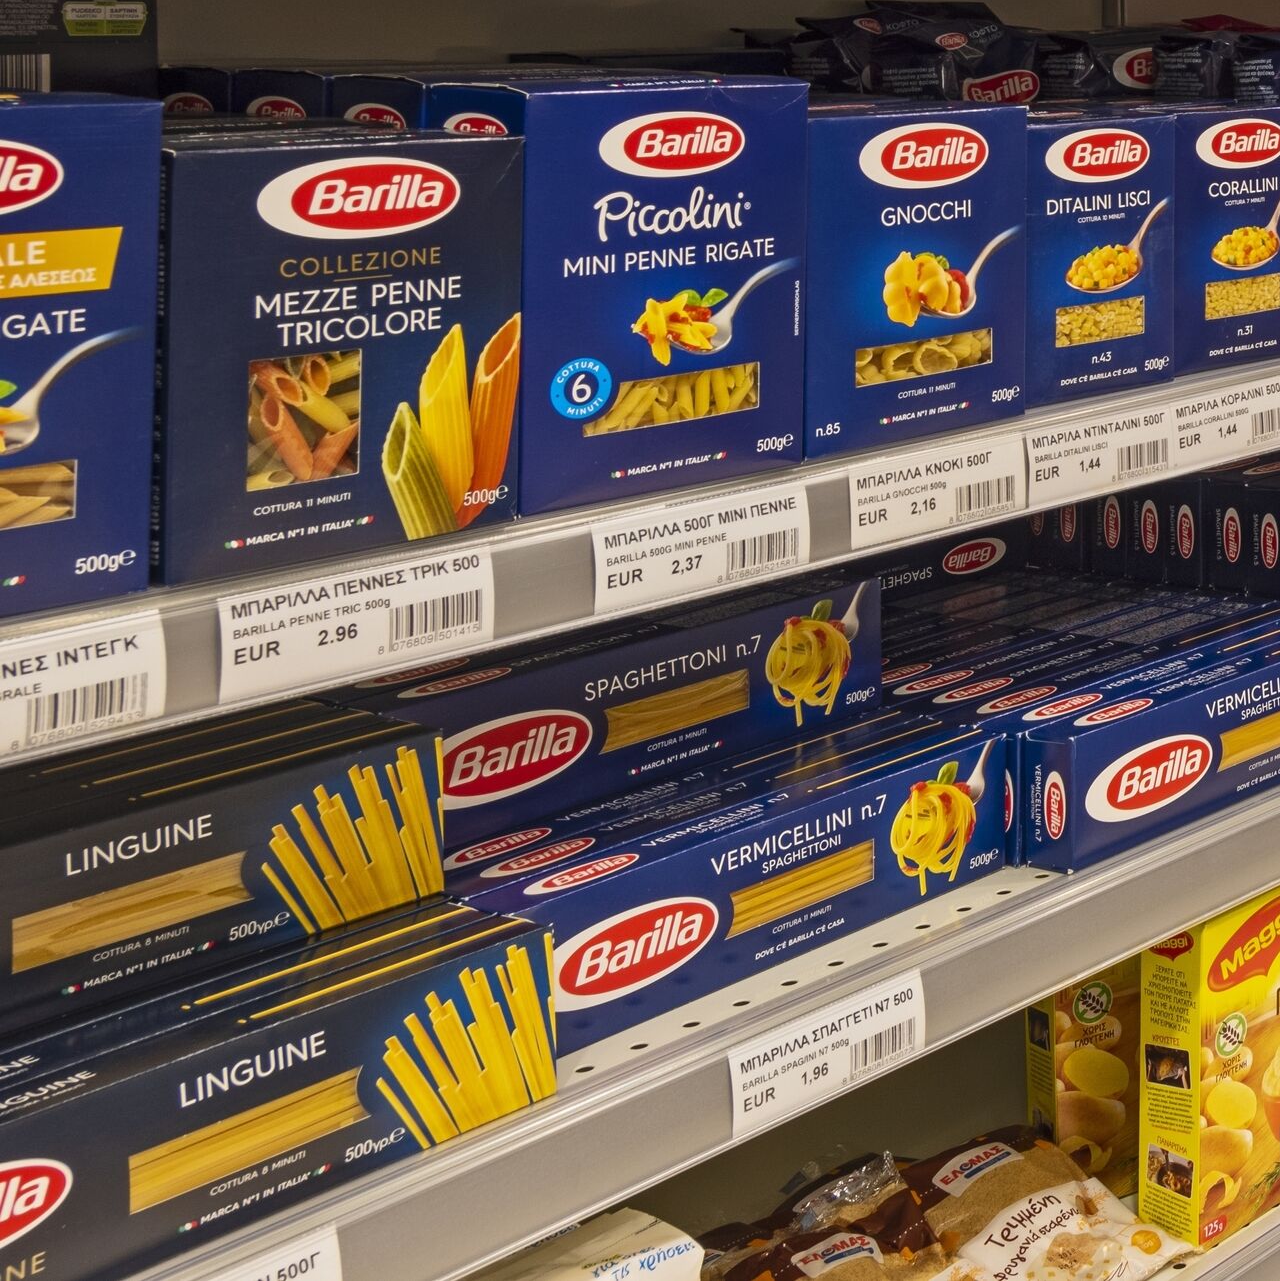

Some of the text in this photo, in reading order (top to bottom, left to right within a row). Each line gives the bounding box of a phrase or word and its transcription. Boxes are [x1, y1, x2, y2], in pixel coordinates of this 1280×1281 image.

[636, 125, 733, 158] Barilla
[892, 137, 978, 170] Barilla
[1072, 139, 1142, 168] Barilla
[1218, 128, 1280, 154] Barilla
[308, 176, 445, 216] Barilla
[1045, 189, 1151, 216] DITALINI LISCI
[1208, 176, 1279, 199] CORALLINI
[594, 186, 743, 241] Piccolini
[881, 200, 972, 227] GNOCCHI
[280, 247, 442, 279] COLLEZIONE
[563, 239, 775, 277] MINI PENNE RIGATE
[255, 276, 462, 319] MEZZE PENNE
[277, 307, 442, 348] TRICOLORE
[815, 422, 841, 439] n.85
[856, 452, 991, 490] ΜΠΑΡΙΛΛΑ ΚΝΟΚΙ 500Γ
[604, 496, 796, 548] ΜΠΑΡΙΛΛΑ 500Γ ΜΙΝΙ ΠΕΝΝΕ
[858, 498, 937, 527] EUR 2,16
[231, 553, 481, 621] ΜΠΑΡΙΛΛΑ ΠΕΝΝΕΣ ΤΡΙΚ 500
[607, 556, 703, 589] EUR 2,37
[56, 634, 140, 667] ΙΝΤΕΓΚ
[233, 622, 359, 666] EUR 2.96
[585, 635, 762, 702] SPAGHETTONI n.7
[447, 724, 578, 788] Barilla
[1116, 746, 1201, 802] Barilla
[66, 814, 213, 876] LINGUINE
[711, 795, 887, 876] VERMICELLINI n.7
[761, 835, 842, 874] SPAGHETTONI
[575, 909, 704, 987] Barilla
[180, 1031, 327, 1107] LINGUINE
[743, 1061, 829, 1113] EUR 1,96
[984, 1192, 1062, 1249] Τριμμένη
